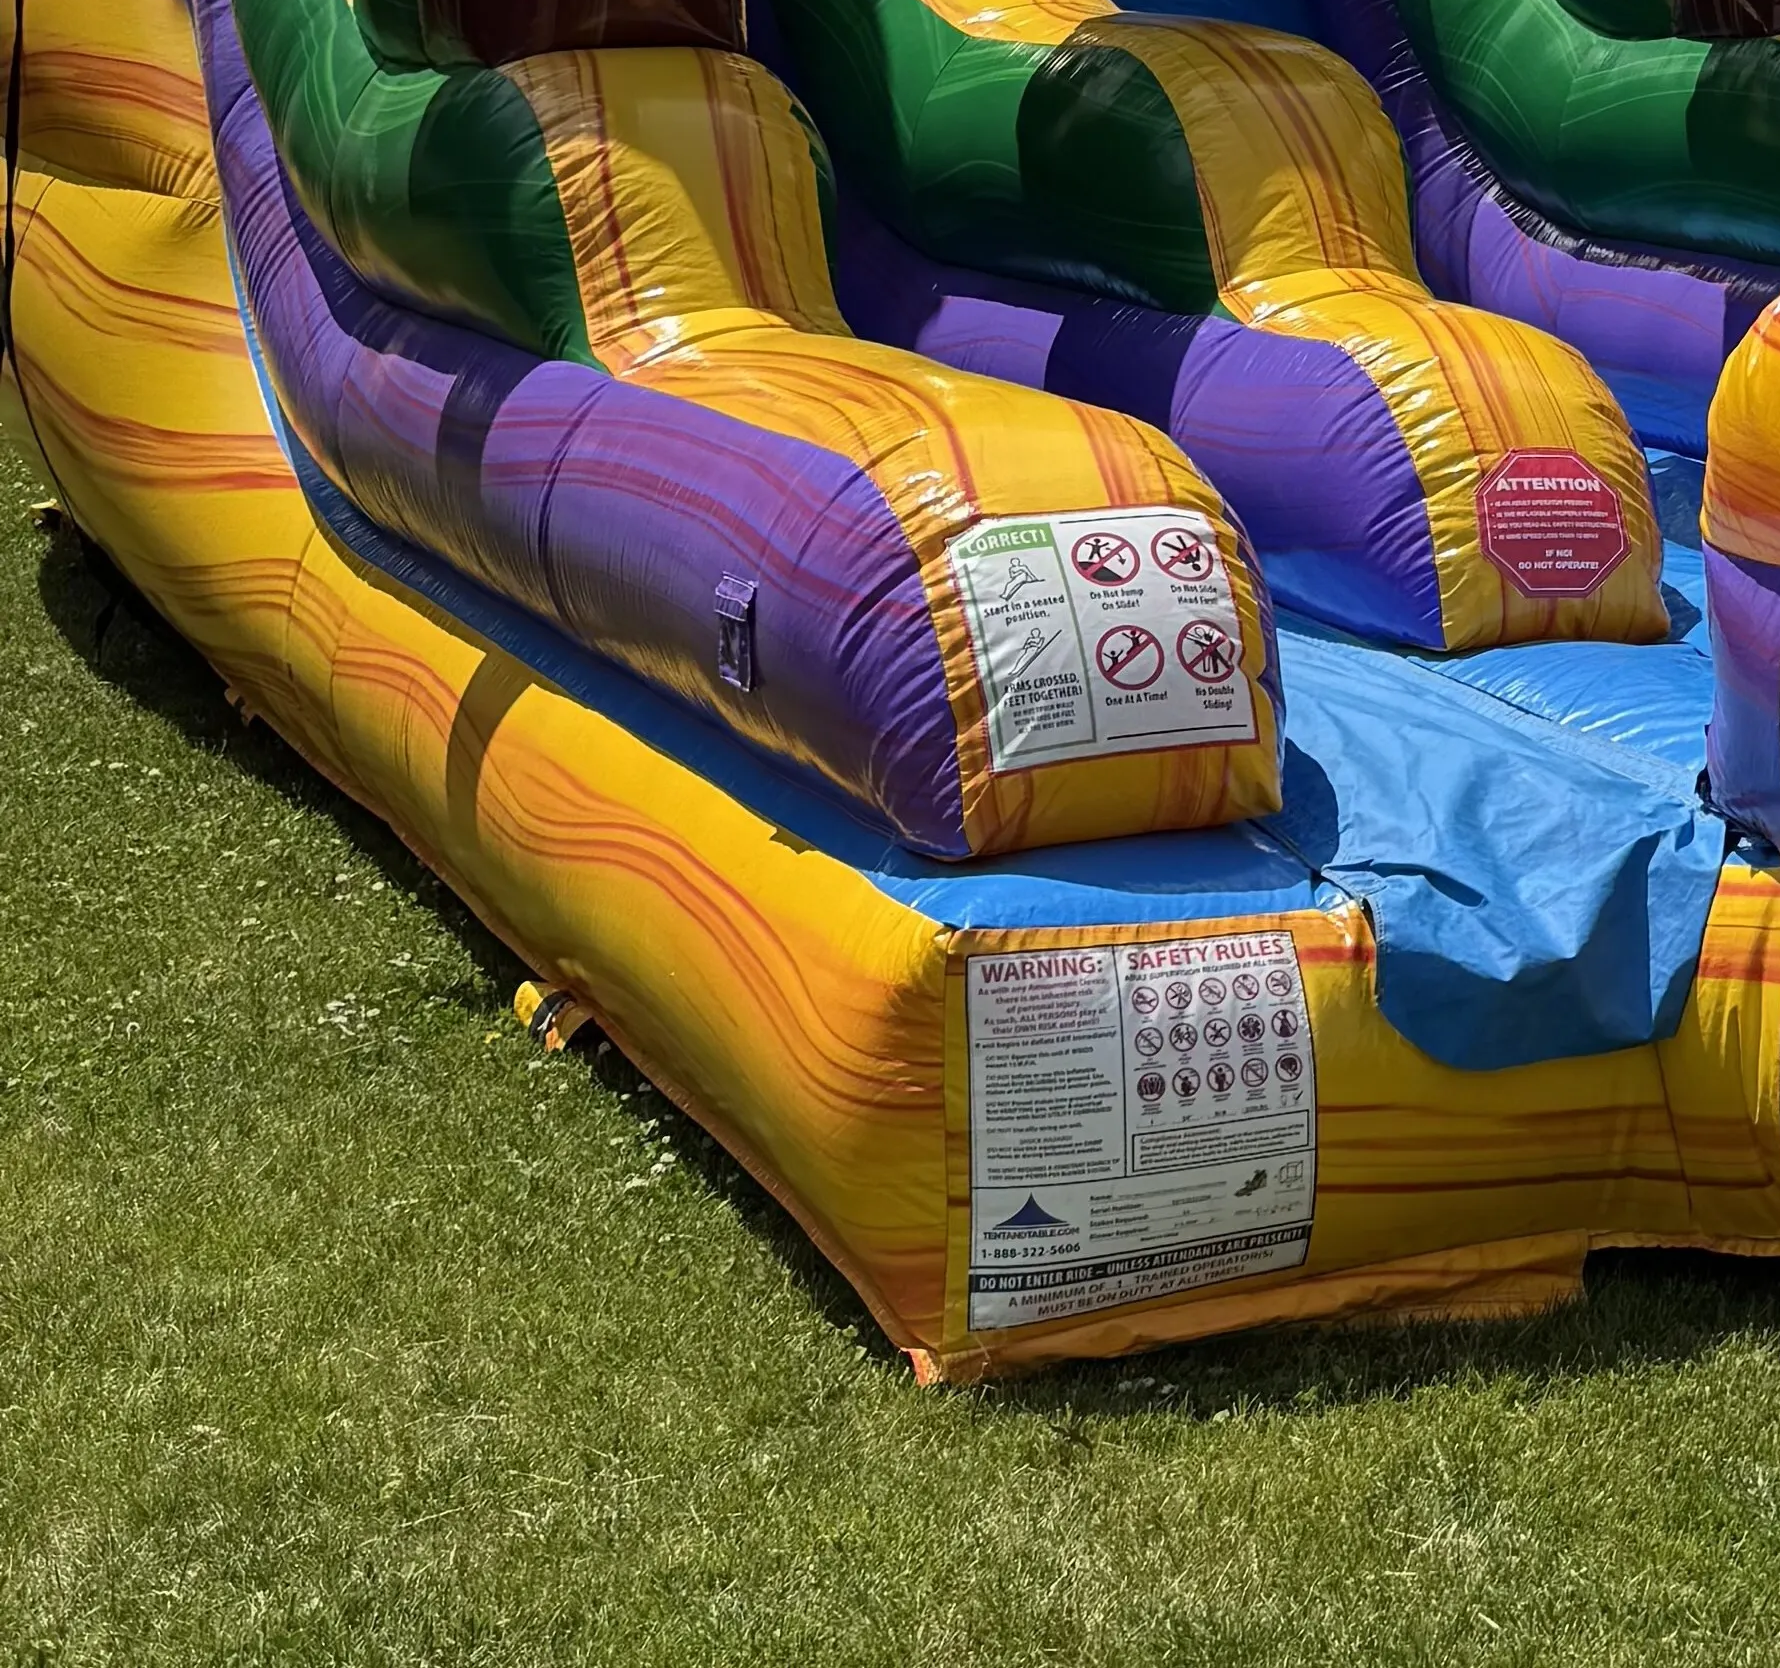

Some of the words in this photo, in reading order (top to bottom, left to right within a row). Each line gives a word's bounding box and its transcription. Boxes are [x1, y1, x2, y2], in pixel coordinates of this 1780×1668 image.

[1496, 477, 1600, 492] ATTENTION
[967, 529, 1047, 554] CORRECT!
[1555, 561, 1599, 570] OPERATE!
[1121, 588, 1144, 597] Jump
[1170, 584, 1181, 593] Do
[984, 604, 1009, 618] Start
[1011, 602, 1021, 611] in
[1032, 594, 1065, 607] seated
[1116, 599, 1140, 609] Slide!
[1178, 596, 1198, 605] Head
[1005, 609, 1050, 627] position.
[1034, 673, 1079, 689] CROSSED,
[1029, 685, 1083, 704] TOGETHER!
[1208, 685, 1235, 696] Double
[1106, 696, 1122, 706] One
[1125, 694, 1135, 704] At
[1136, 694, 1142, 703] A
[1144, 691, 1168, 702] Time!
[1203, 699, 1232, 710] Sliding!
[1127, 945, 1209, 971] SAFETY
[1216, 939, 1284, 961] RULES
[981, 957, 1103, 983] WARNING:
[1202, 963, 1241, 973] REQUIRED
[996, 995, 1018, 1004] there
[1017, 1003, 1054, 1014] personal
[1038, 1010, 1077, 1021] PERSONS
[1014, 1025, 1037, 1034] OWN
[1038, 1022, 1057, 1031] RISK
[983, 1227, 1080, 1240] TENTANDTABLE.COM
[981, 1243, 1081, 1259] 1-888-322-5606
[980, 1278, 996, 1290] DO
[1000, 1276, 1023, 1289] NOT
[1026, 1270, 1063, 1287] ENTER
[1066, 1267, 1093, 1281] RIDE
[1107, 1258, 1150, 1275] UNLESS
[1152, 1244, 1223, 1266] ATTENDANTS
[1225, 1238, 1248, 1251] ARE
[1250, 1228, 1302, 1247] PRESENT!
[1009, 1297, 1017, 1307] A
[1021, 1286, 1085, 1305] MINIMUM
[1089, 1282, 1105, 1295] OF
[1118, 1280, 1122, 1289] 1
[1135, 1266, 1189, 1284] TRAINED
[1192, 1250, 1273, 1272] OPERATOR(S)
[1038, 1302, 1075, 1316] MUST
[1078, 1296, 1094, 1307] BE
[1096, 1291, 1116, 1303] ON
[1119, 1286, 1153, 1300] DUTY
[1160, 1280, 1177, 1290] AT
[1178, 1275, 1200, 1287] ALL
[1204, 1266, 1245, 1281] TIMES!
